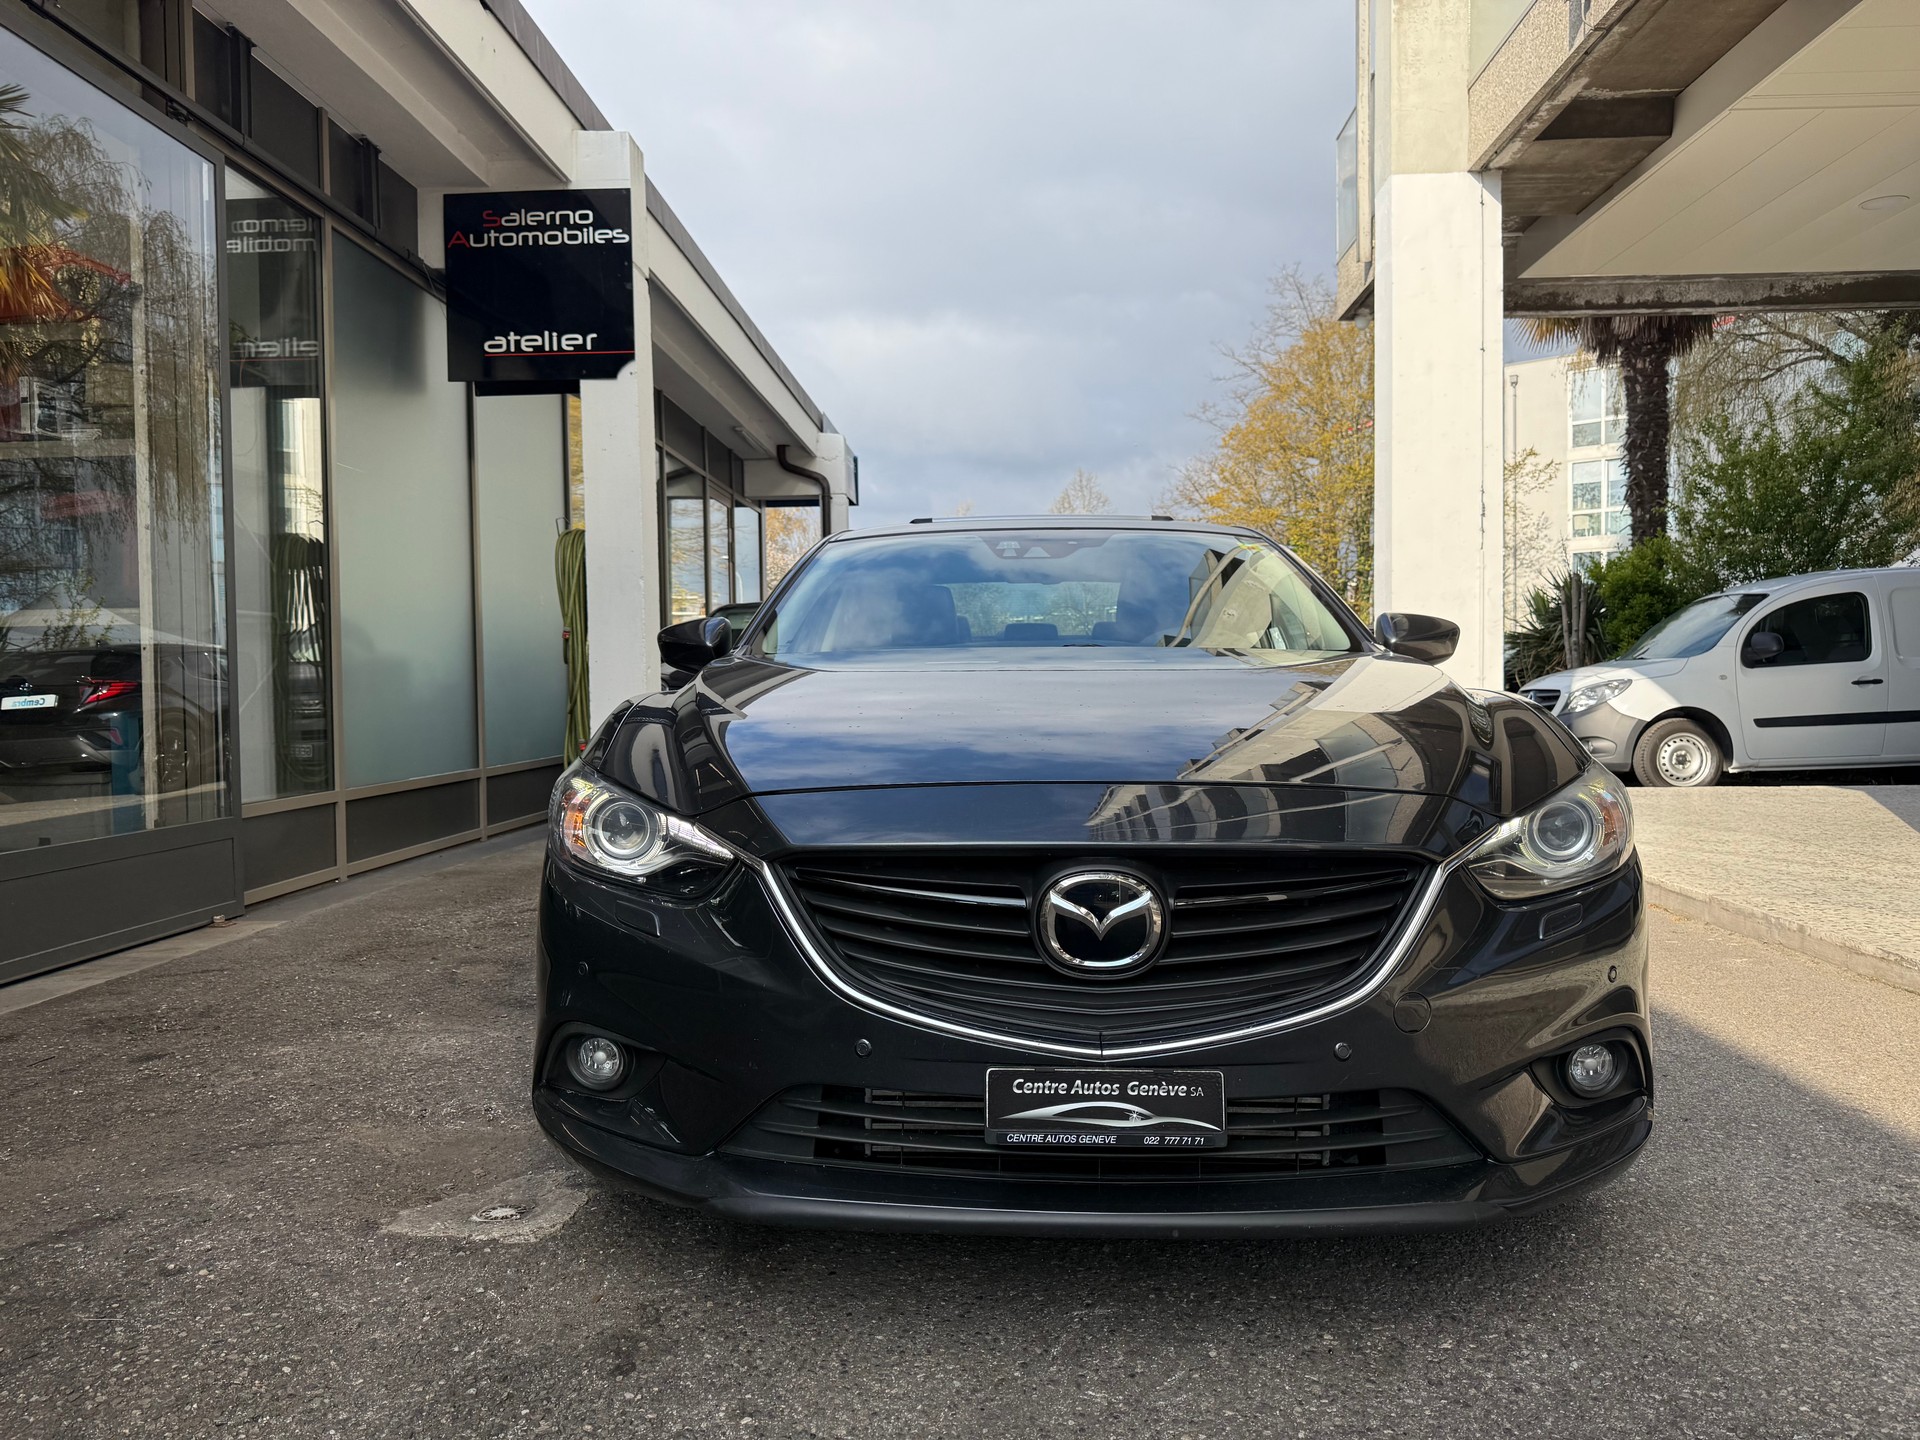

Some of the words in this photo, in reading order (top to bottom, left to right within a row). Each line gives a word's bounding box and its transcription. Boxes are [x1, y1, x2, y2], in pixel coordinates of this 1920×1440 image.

[482, 209, 593, 227] Salerno
[448, 226, 630, 248] Automobiles
[483, 330, 598, 353] atelier
[1012, 1078, 1068, 1095] Centre
[1070, 1079, 1120, 1096] Autos
[1126, 1081, 1188, 1097] Genève
[1190, 1087, 1204, 1097] SA
[1006, 1133, 1045, 1143] CENTRE
[1045, 1134, 1077, 1144] AUTOS
[1078, 1135, 1117, 1144] GENEVE
[1143, 1136, 1160, 1145] 022
[1164, 1136, 1180, 1145] 777
[1182, 1136, 1192, 1145] 71
[1194, 1136, 1205, 1145] 71
